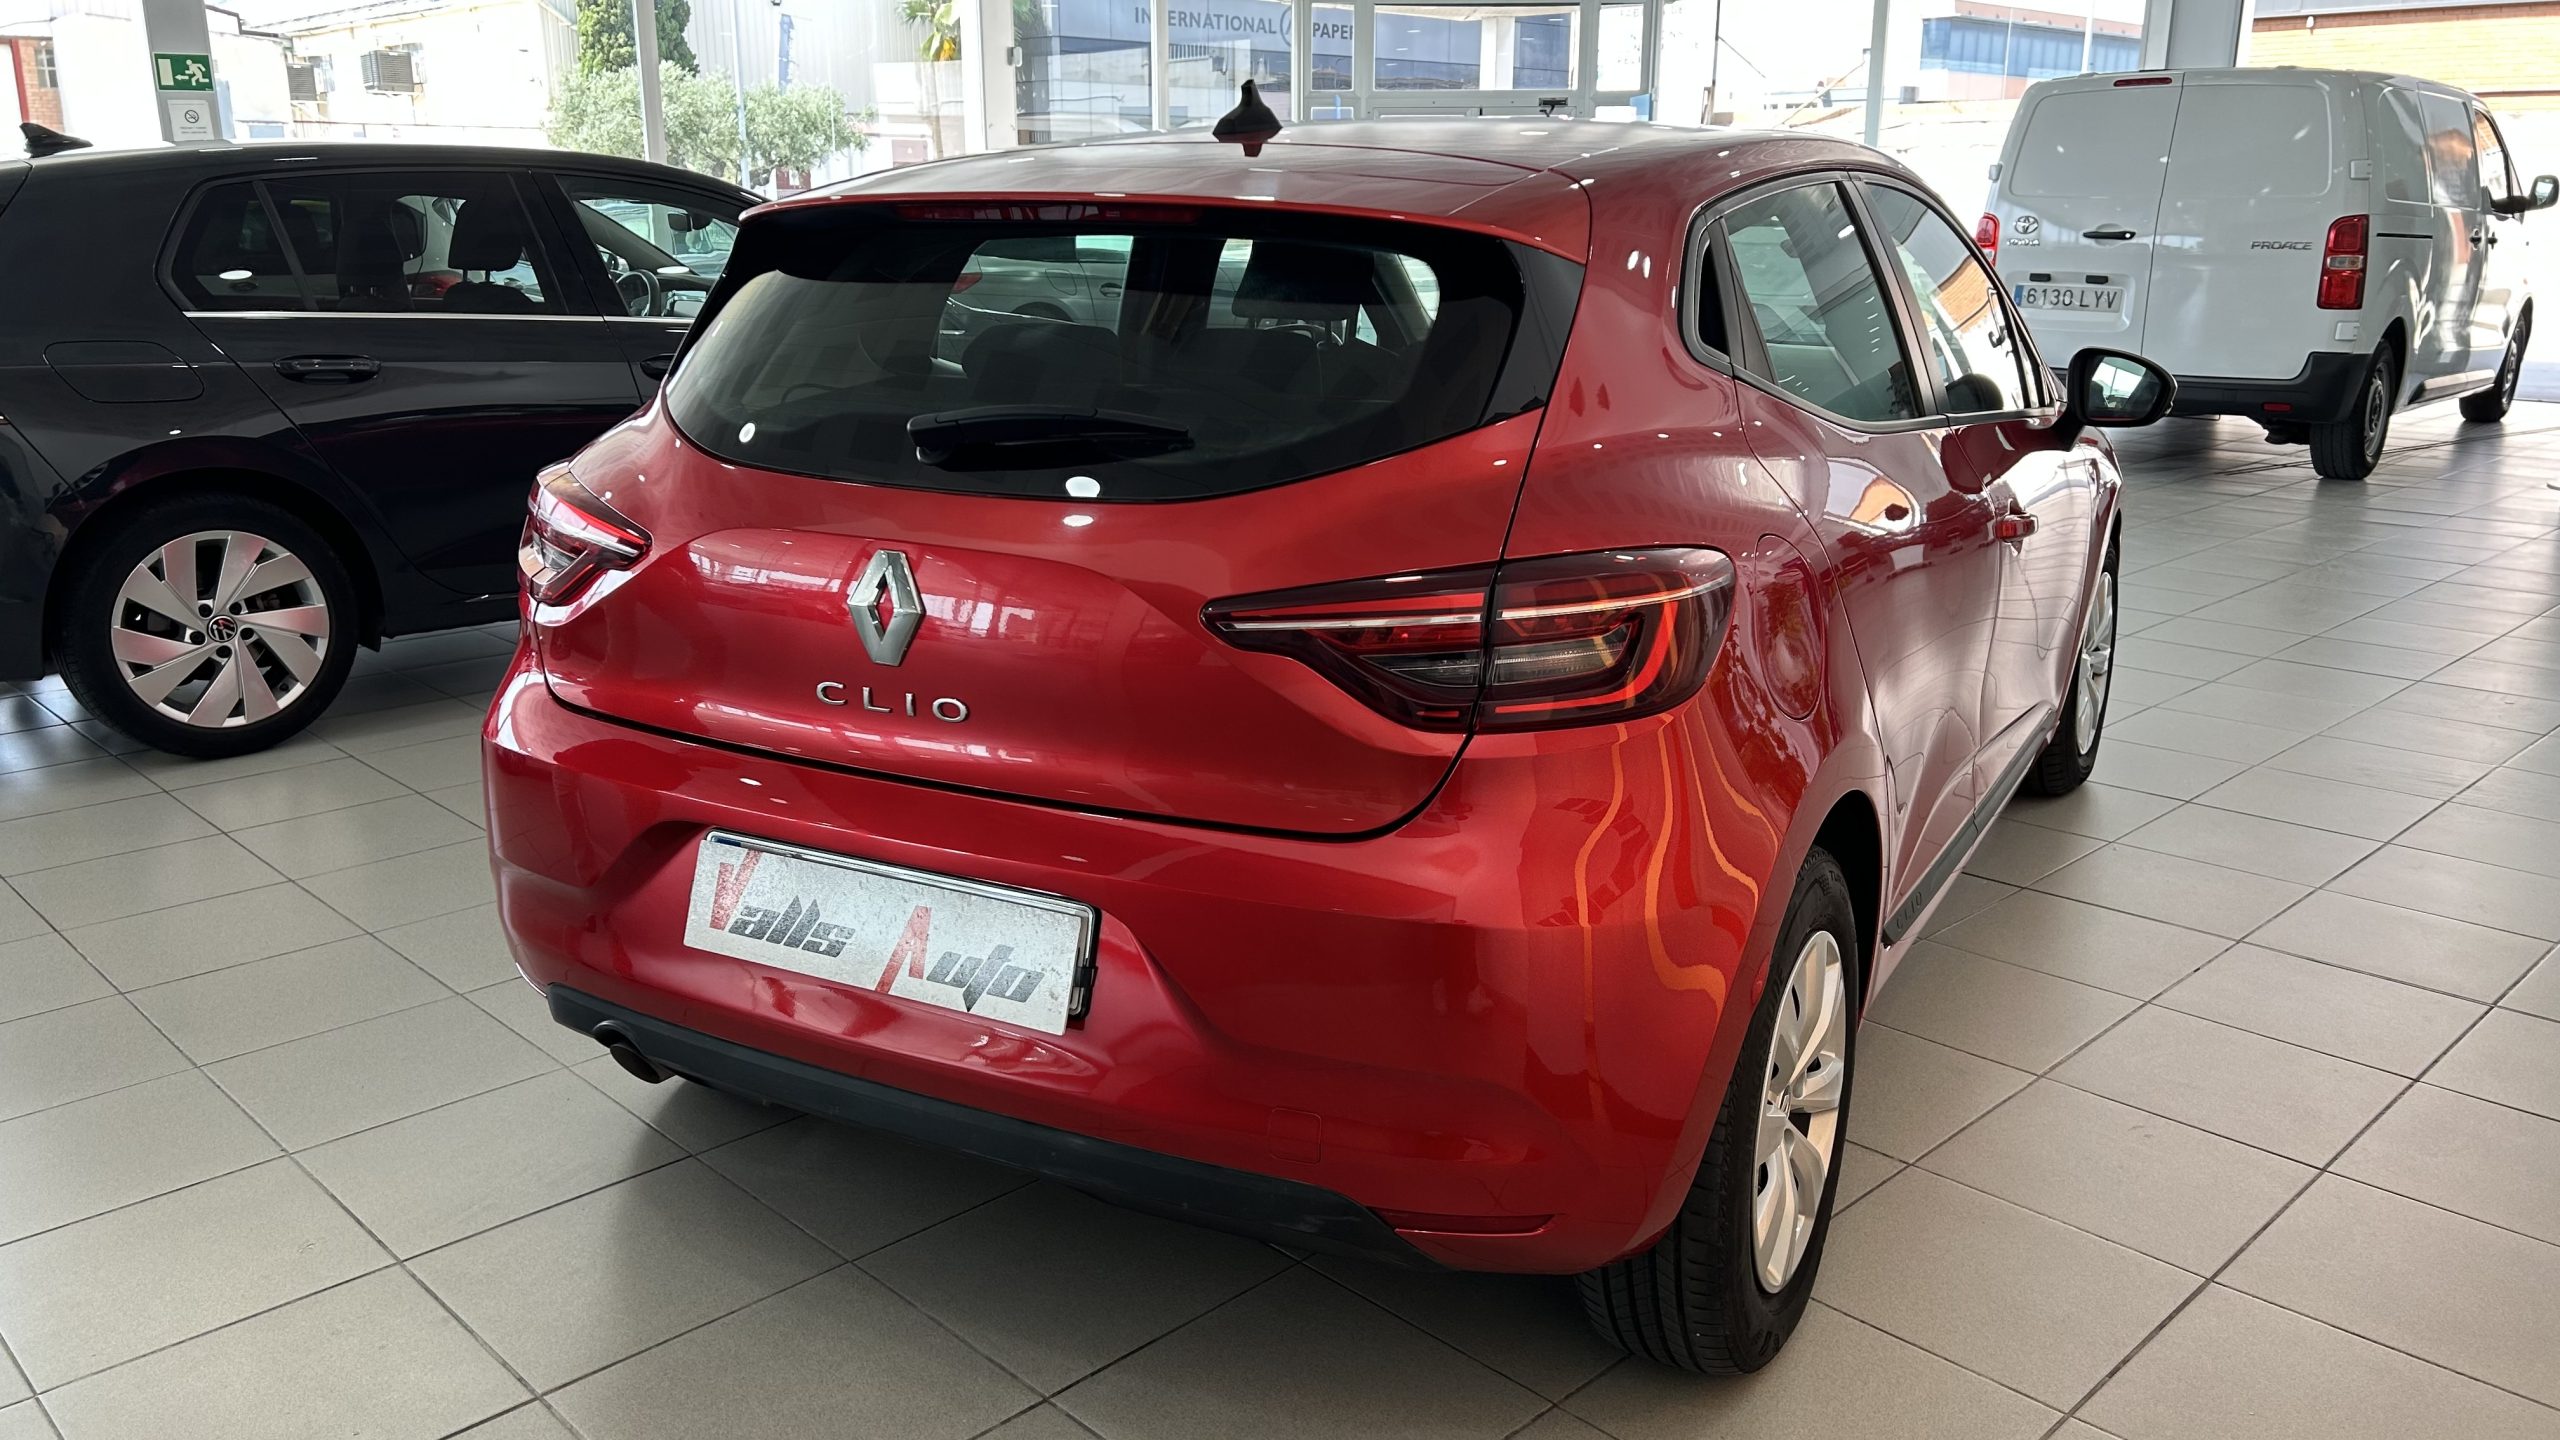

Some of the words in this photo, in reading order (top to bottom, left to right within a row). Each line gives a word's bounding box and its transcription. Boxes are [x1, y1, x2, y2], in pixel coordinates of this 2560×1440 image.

[1134, 7, 1277, 34] INERNATIONAL
[2250, 240, 2313, 251] PROACE
[2026, 287, 2074, 307] 6130
[2079, 290, 2118, 309] LYV
[816, 681, 969, 723] CLIO
[709, 850, 857, 958] Valls
[874, 904, 1045, 1012] Auto
